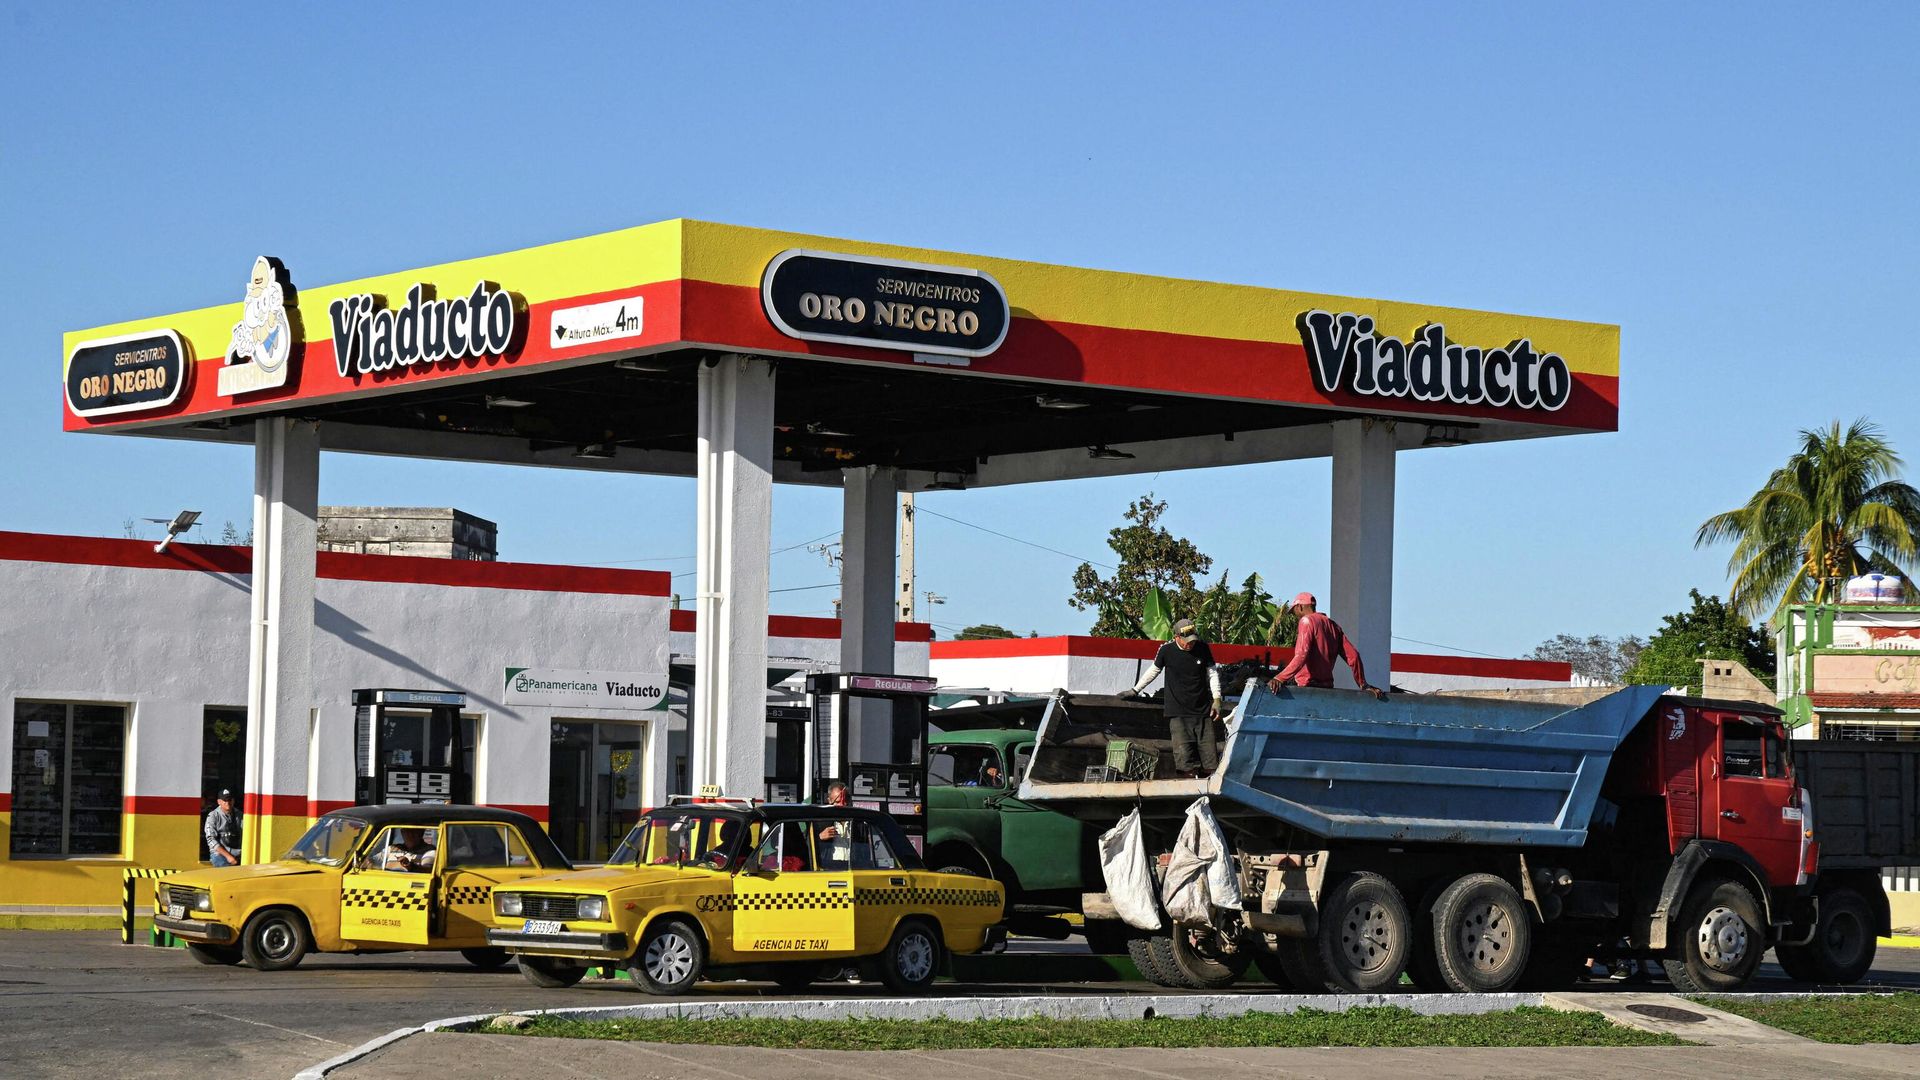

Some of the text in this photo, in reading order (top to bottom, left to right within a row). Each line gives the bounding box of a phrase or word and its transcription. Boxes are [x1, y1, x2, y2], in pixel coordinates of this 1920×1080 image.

[877, 277, 980, 304] SERVICENTROS
[569, 328, 591, 340] Altura
[616, 305, 639, 331] 4m
[799, 292, 979, 336] ORO NEGRO
[331, 284, 513, 375] Viaducto
[114, 345, 167, 366] SERVICENTROS
[1306, 309, 1571, 411] Viaducto
[80, 366, 166, 399] ORO NEGRO
[528, 678, 661, 698] Panamericana Viaducto
[875, 679, 912, 690] REGULAR
[409, 694, 442, 702] ESPECIAL
[701, 785, 719, 793] TAXI
[388, 919, 401, 927] TAXIS
[753, 939, 829, 949] AGENCIA DE TAXI
